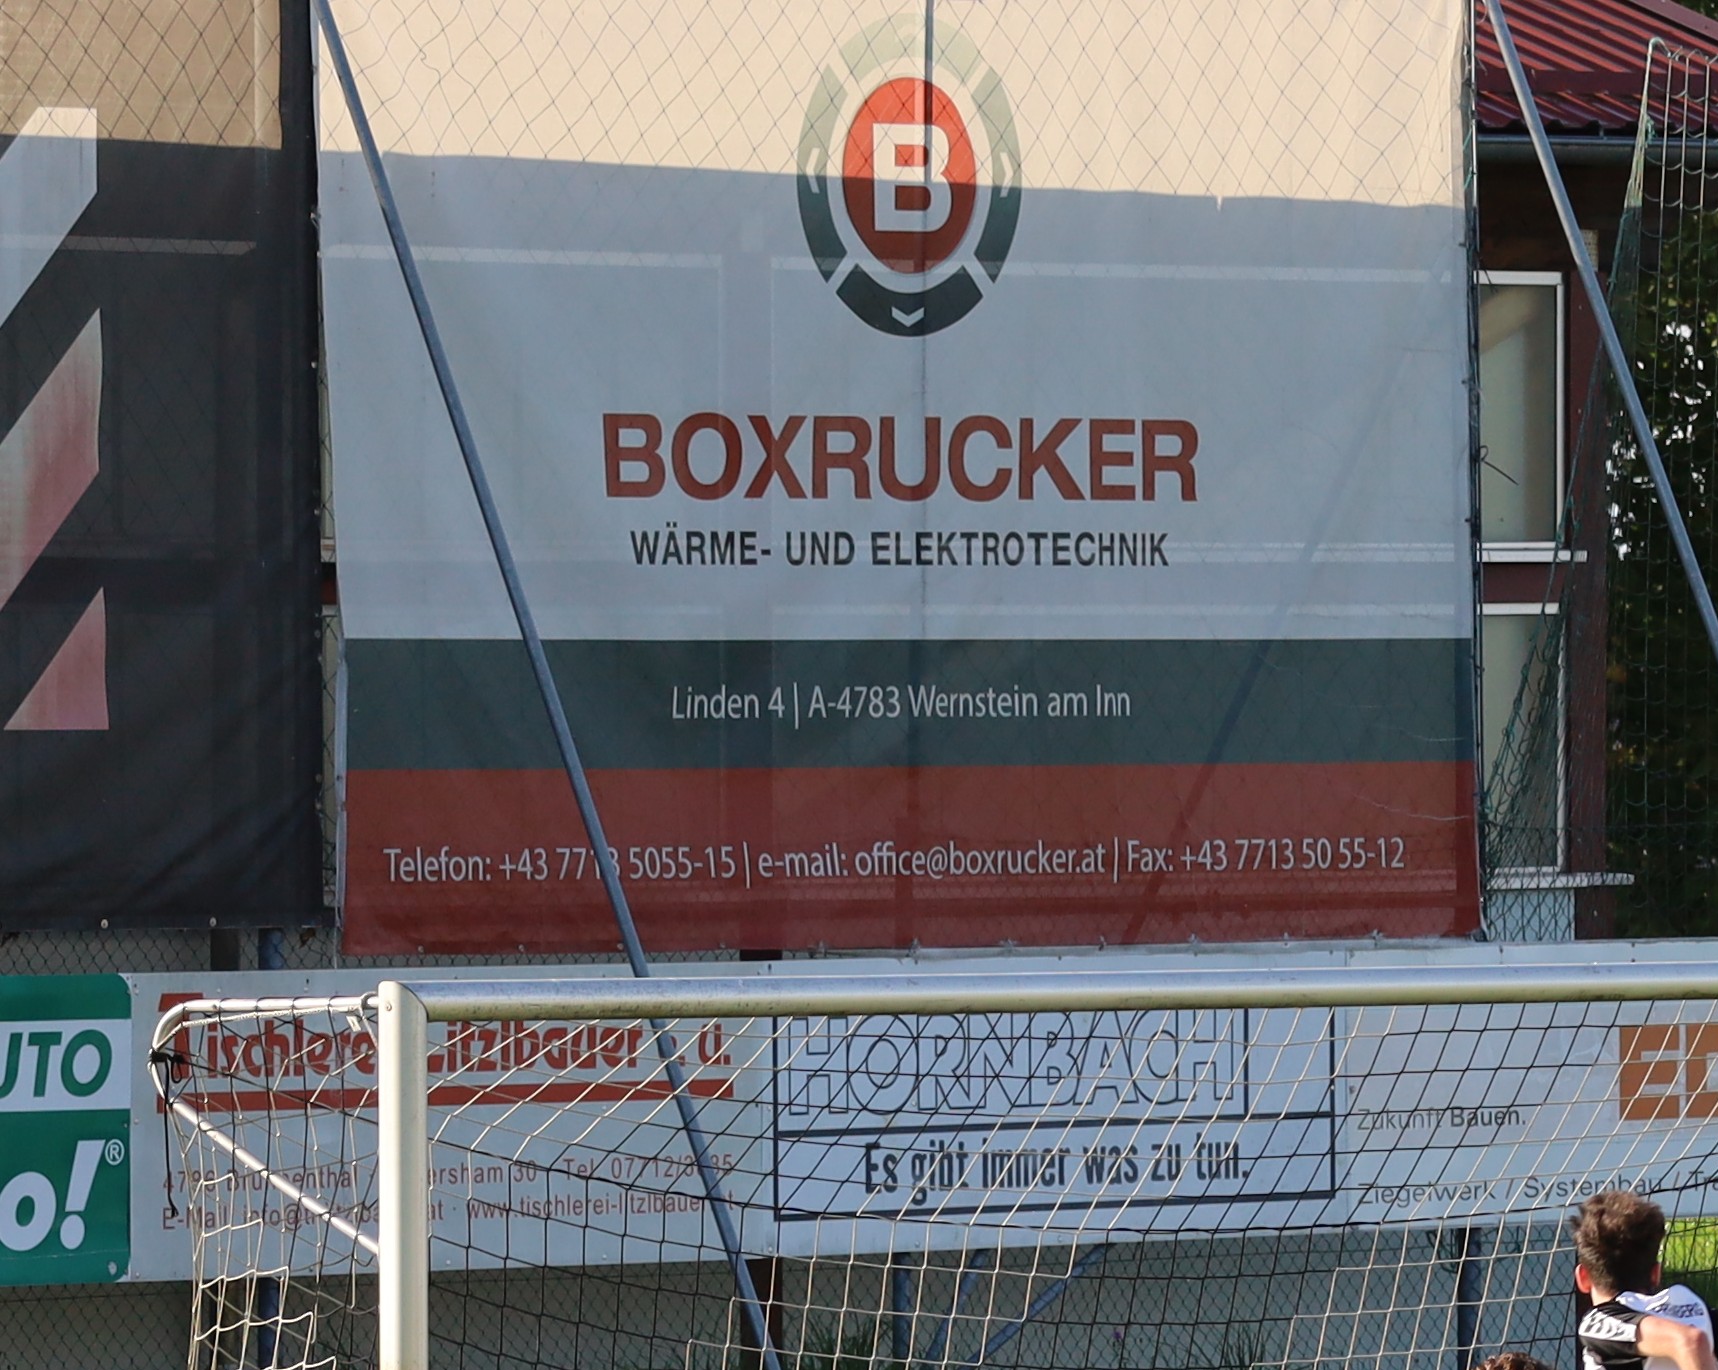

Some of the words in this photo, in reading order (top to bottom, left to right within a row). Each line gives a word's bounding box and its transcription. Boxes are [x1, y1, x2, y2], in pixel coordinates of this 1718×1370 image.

[872, 122, 950, 233] B
[602, 412, 1199, 502] BOXRUCKER
[630, 521, 771, 566] WÄRME-
[786, 530, 855, 566] UND
[871, 531, 1169, 567] ELEKTROTECHNIK
[671, 685, 760, 719] Linden
[768, 686, 785, 718] 4
[807, 685, 900, 719] A-4783
[908, 684, 1038, 718] Wernstein
[1047, 691, 1087, 717] am
[1096, 684, 1131, 717] Inn
[383, 846, 491, 882] Telefon:
[499, 847, 548, 881] +43
[629, 846, 736, 880] 5055-15
[758, 841, 848, 876] e-mail:
[855, 839, 1105, 880] office@boxrucker.at
[1127, 839, 1174, 872] Fax:
[1180, 839, 1227, 872] +43
[1235, 838, 1294, 871] 7713
[1302, 837, 1332, 870] 50
[1338, 836, 1405, 870] 55-12
[788, 1010, 1233, 1117] HORNBACH
[1357, 1107, 1442, 1132] Zukunft
[1450, 1105, 1526, 1129] Bauen.
[866, 1143, 898, 1194] Es
[911, 1141, 970, 1205] gibt
[982, 1137, 1071, 1190] immer
[1083, 1139, 1139, 1185] was
[1151, 1143, 1181, 1181] zu
[1195, 1132, 1249, 1180] tun.
[1358, 1180, 1496, 1208] Ziegelwerk
